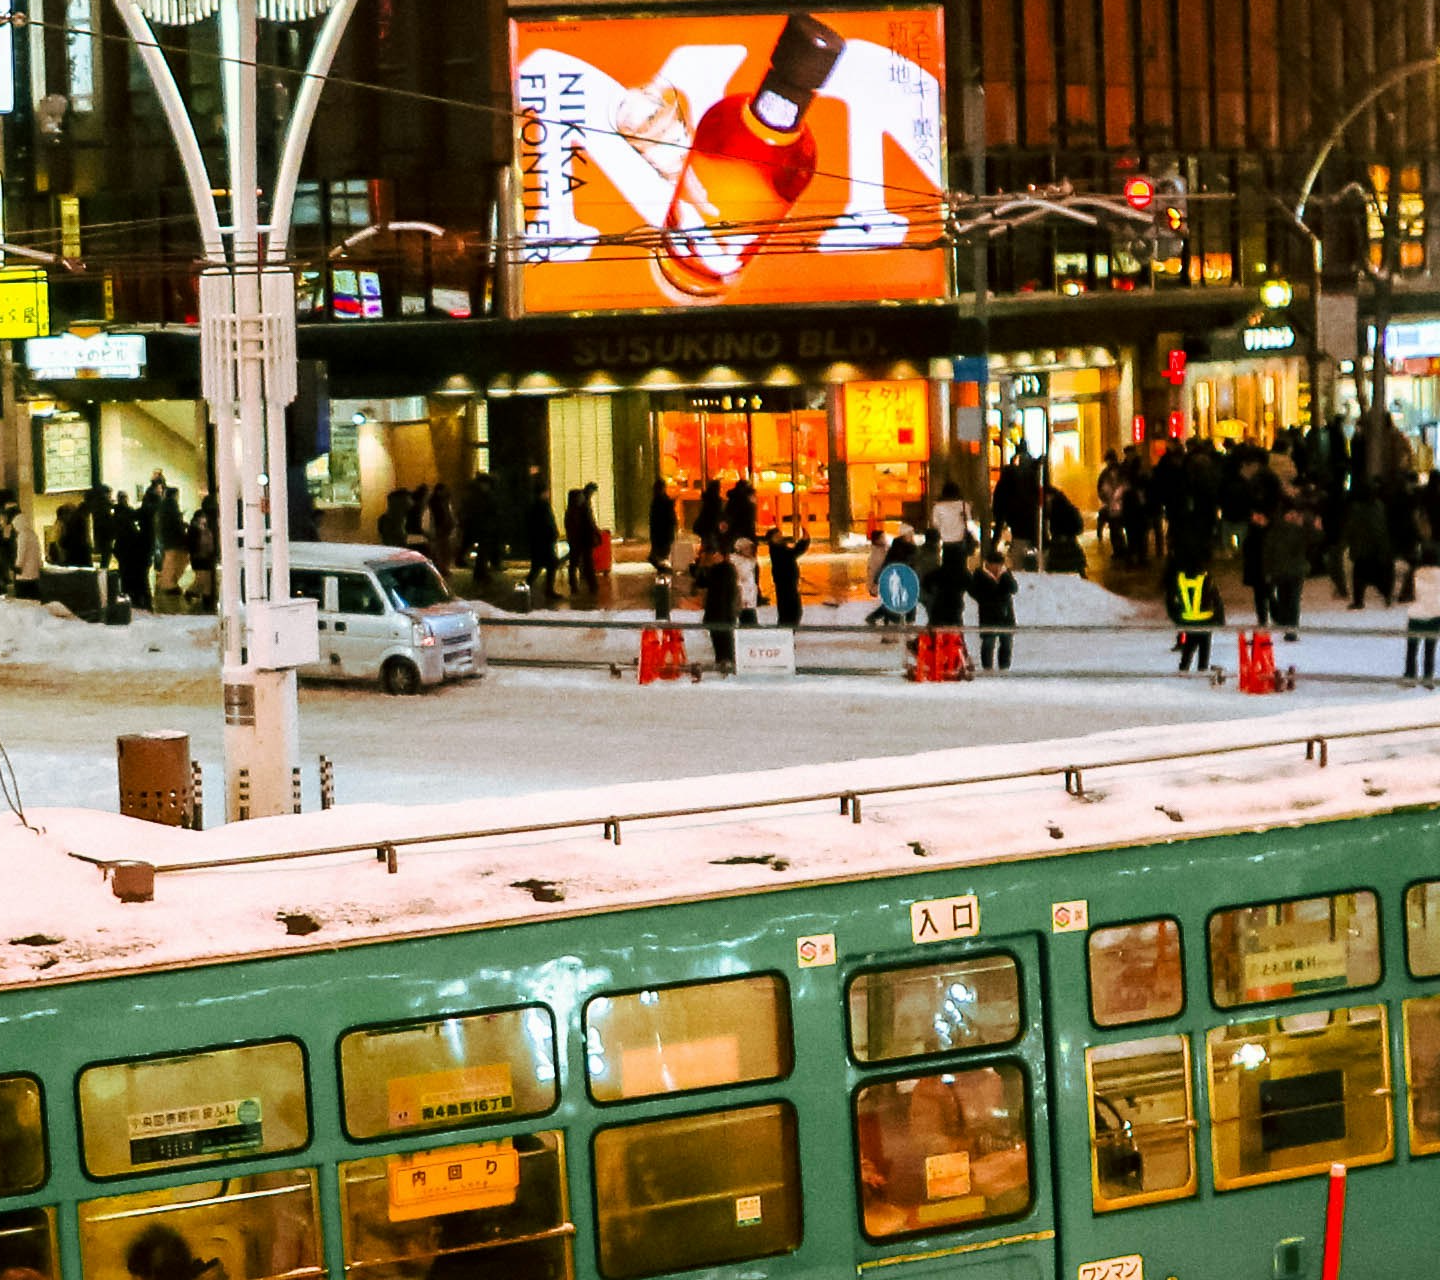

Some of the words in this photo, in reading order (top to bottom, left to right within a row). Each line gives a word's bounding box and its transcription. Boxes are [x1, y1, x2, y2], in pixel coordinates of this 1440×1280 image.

[558, 73, 587, 196] NIKKA
[520, 74, 552, 265] FRONTIER
[573, 330, 783, 368] SUSUKINO
[799, 326, 890, 359] BLD.
[918, 902, 975, 937] 入口
[411, 1158, 499, 1187] 内回り
